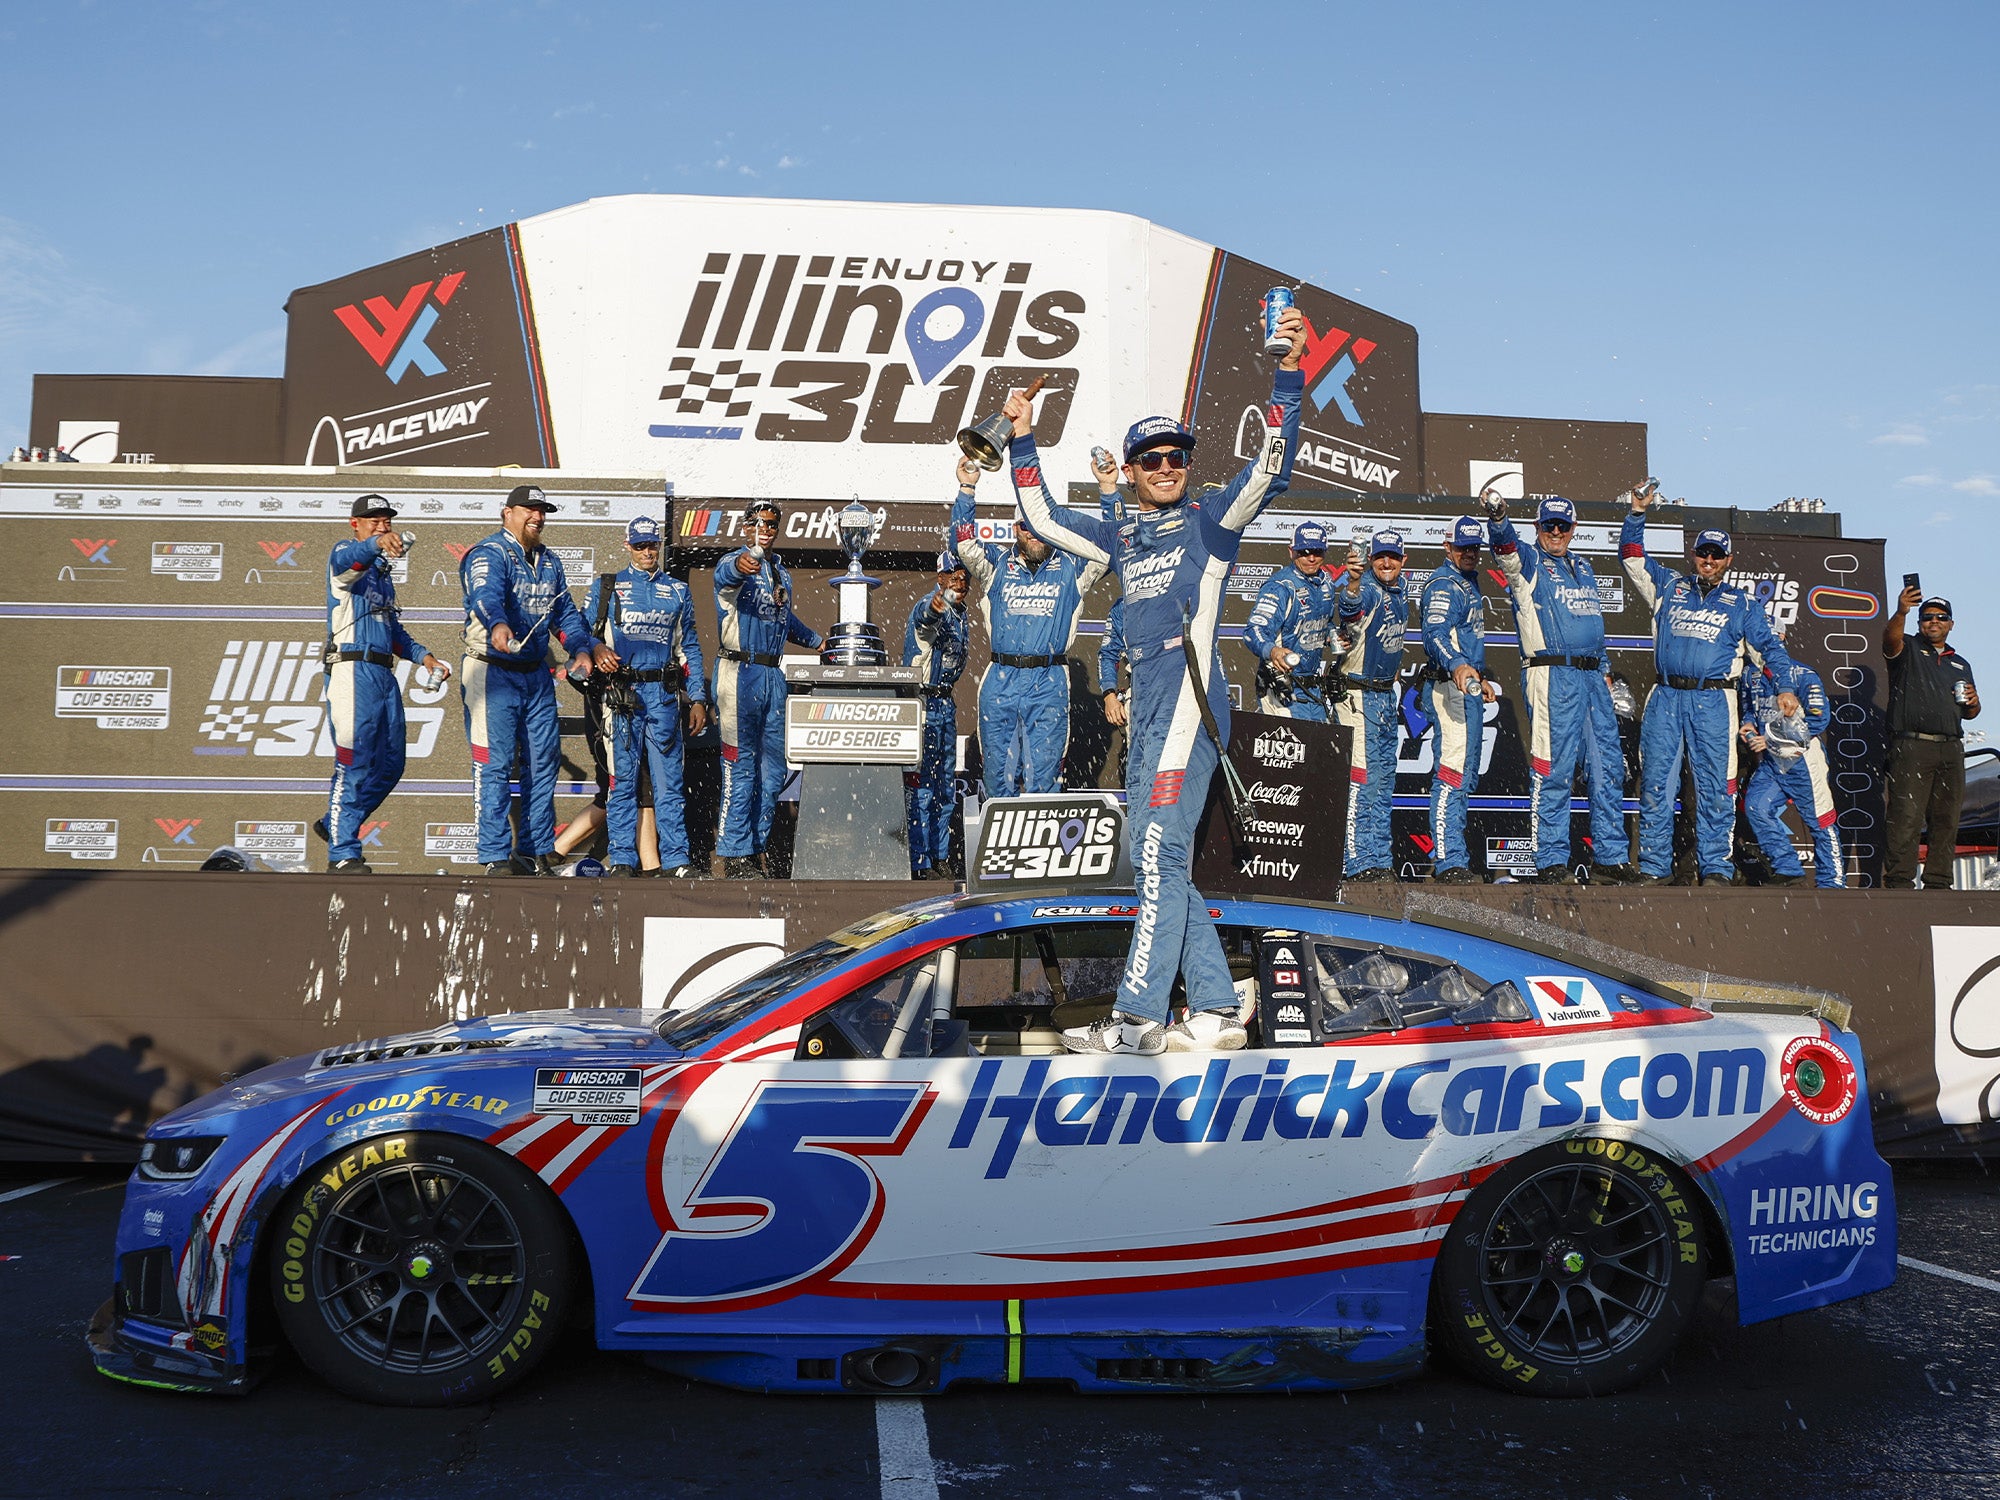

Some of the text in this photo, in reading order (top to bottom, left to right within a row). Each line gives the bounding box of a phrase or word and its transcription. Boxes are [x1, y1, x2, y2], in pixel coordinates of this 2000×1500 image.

[840, 256, 998, 283] ENJOY
[676, 252, 1086, 362] illinois
[754, 359, 1080, 448] 300
[344, 397, 490, 453] RACEWAY
[1138, 418, 1178, 434] Hendrick
[1294, 441, 1400, 489] ACEWAY
[975, 522, 1017, 539] obi
[174, 545, 212, 555] NASCAR
[161, 558, 212, 568] CUP SERIES
[563, 563, 584, 572] RIES
[1123, 546, 1185, 583] Hendrick
[1237, 566, 1273, 576] NASCAR
[1227, 579, 1264, 588] CUP SERI
[1739, 572, 1778, 580] ENJOY
[1002, 582, 1060, 601] Hendrick
[1007, 597, 1055, 609] Cars.com
[620, 608, 676, 626] endrick
[1669, 606, 1730, 628] Hendrick
[622, 623, 670, 637] Cars.com
[1671, 620, 1720, 637] Cars.com
[93, 671, 154, 686] NASCAR
[209, 641, 453, 704] illinis
[891, 671, 914, 679] xfinity
[72, 692, 154, 707] CUP SERIES
[830, 704, 901, 722] NASCAR
[106, 717, 160, 727] THE CHASE
[253, 705, 445, 758] 30
[806, 731, 901, 747] CUP SERIES
[1253, 738, 1306, 763] BUSCH
[1262, 759, 1295, 769] LIGHT
[1249, 781, 1303, 807] Coca-Cola
[1038, 808, 1089, 819] ENJOY
[68, 822, 108, 831] NASCAR
[257, 824, 297, 834] NASCAR
[986, 807, 1116, 848] illinois
[55, 835, 107, 845] CUP SERIES
[244, 838, 296, 847] CUP SERIES
[435, 840, 476, 850] CUP SERI
[1243, 835, 1303, 847] INSURANCE
[1014, 845, 1114, 879] 300
[1496, 854, 1533, 863] CUP SERI
[1240, 854, 1300, 881] xfinity
[1277, 1005, 1305, 1018] MAC
[1548, 1009, 1601, 1021] Valvoline
[1784, 1038, 1849, 1064] PHORM ENERGY
[568, 1071, 626, 1085] NASCAR
[548, 1090, 626, 1105] CUP SERIES
[1788, 1089, 1854, 1122] PHORM ENERGY
[325, 1088, 509, 1127] GOODYEAR
[948, 1046, 1767, 1179] HendrickCars.com
[580, 1113, 632, 1123] THE CHASE
[628, 1080, 938, 1312] 5
[1750, 1182, 1879, 1226] HIRING
[282, 1138, 408, 1303] GOODYEAR
[1748, 1226, 1876, 1255] TECHNICIANS
[486, 1289, 550, 1380] EAGLE
[1464, 1312, 1540, 1383] EAGLE
